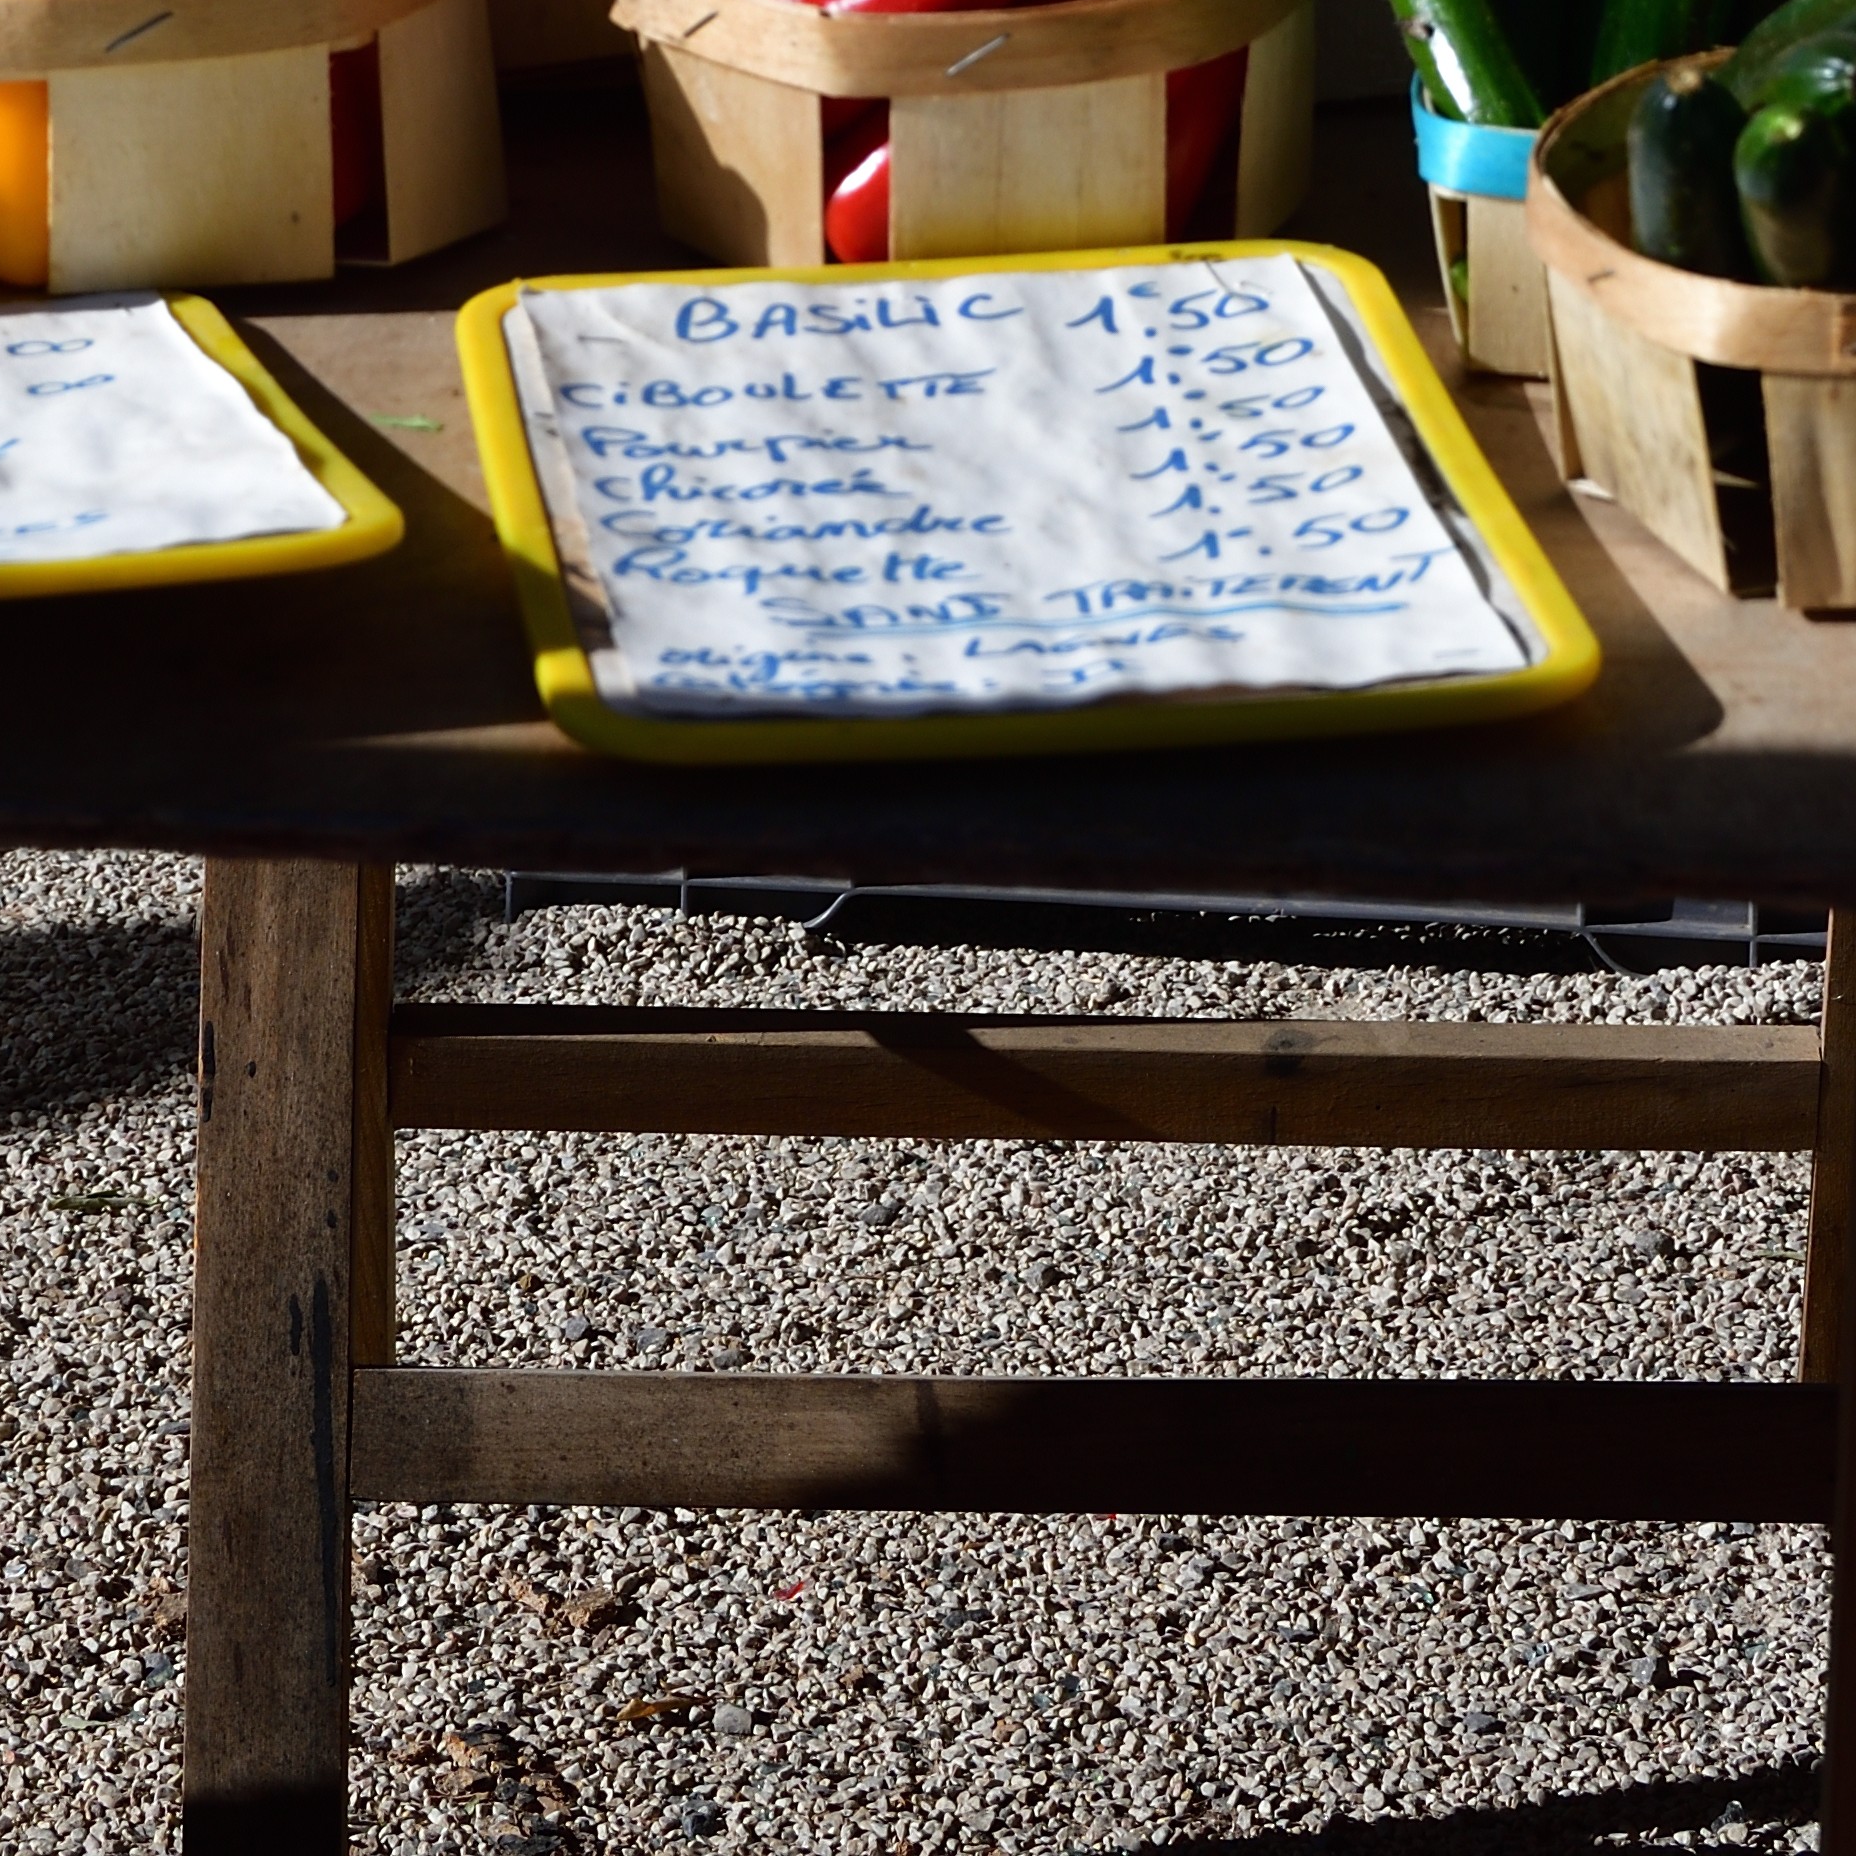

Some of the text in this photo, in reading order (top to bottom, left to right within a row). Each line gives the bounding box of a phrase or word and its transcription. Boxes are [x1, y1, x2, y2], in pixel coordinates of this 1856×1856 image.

[580, 425, 935, 464] Pourpier
[599, 504, 1013, 545] Coriandre
[612, 545, 982, 595] Roquette
